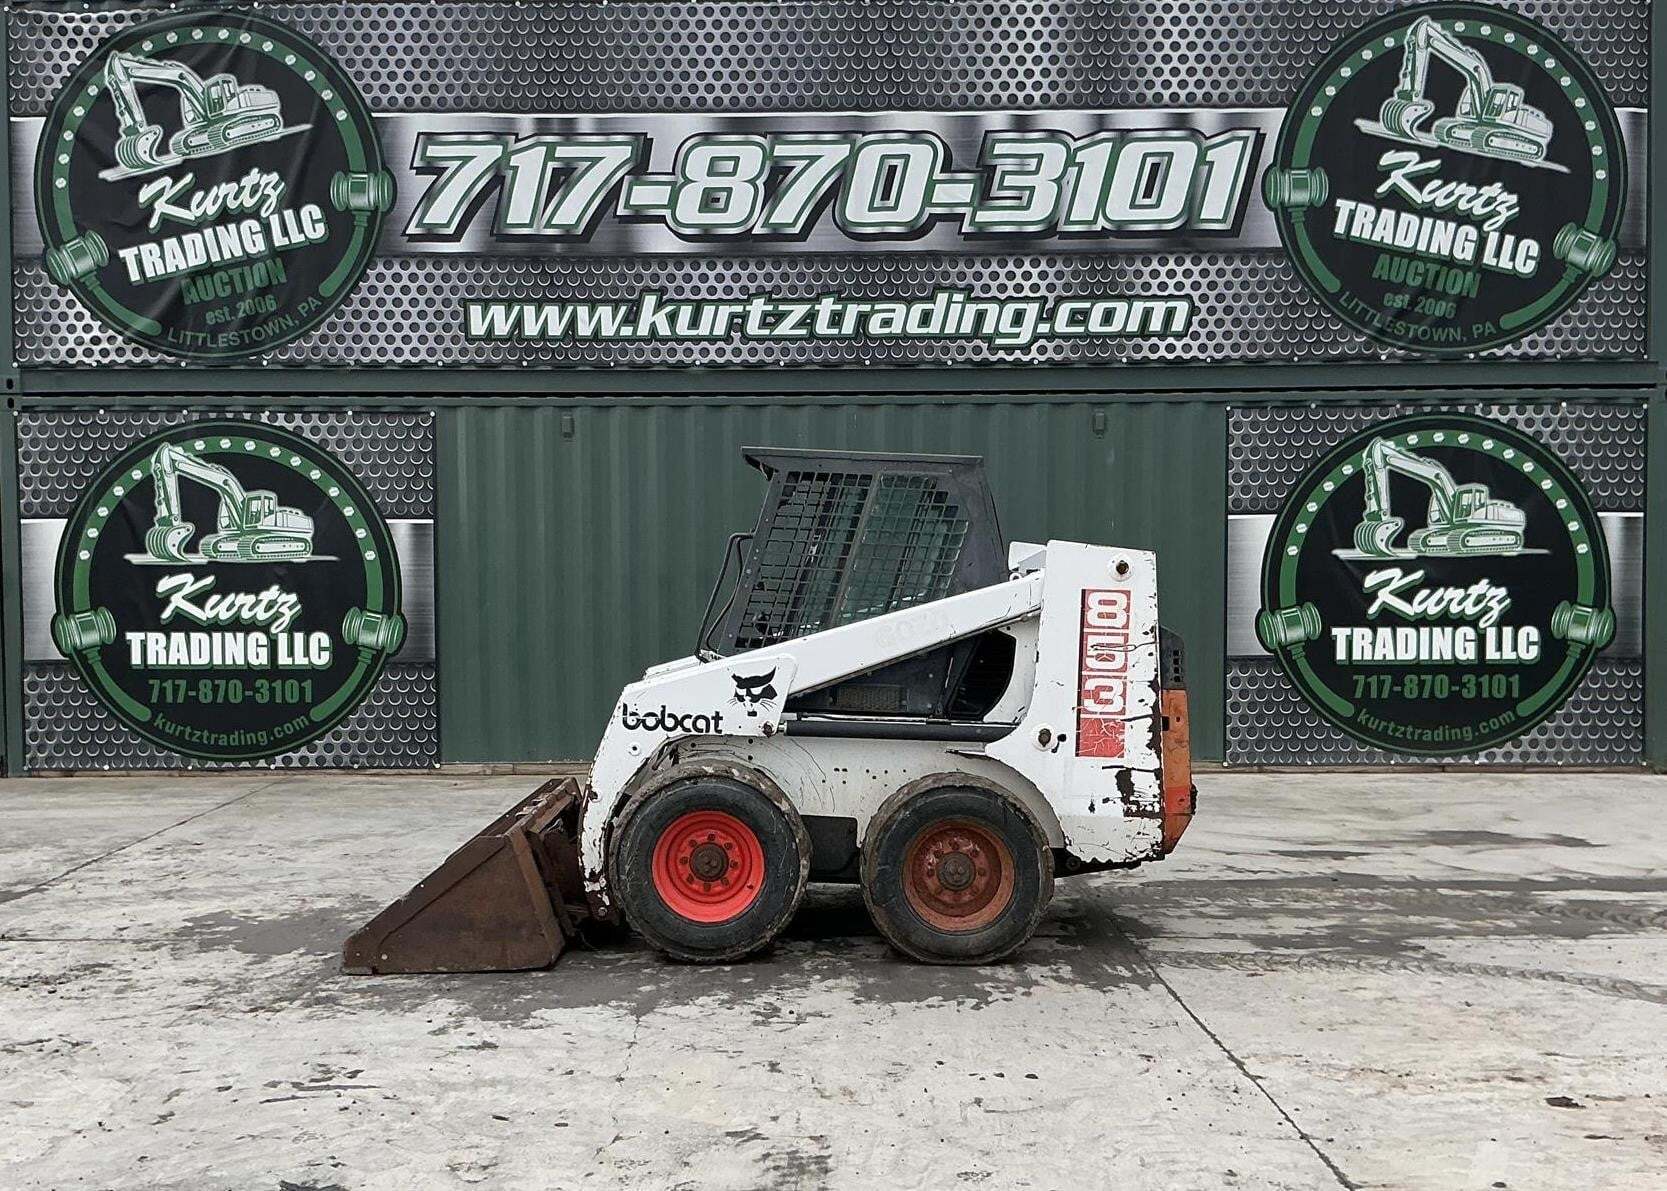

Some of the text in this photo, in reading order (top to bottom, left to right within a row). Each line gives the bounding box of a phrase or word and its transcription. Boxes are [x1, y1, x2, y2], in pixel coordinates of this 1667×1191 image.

[138, 168, 286, 229] Kurtz
[409, 132, 1260, 238] 717-870-3101
[1375, 149, 1521, 231] Kurtz
[118, 203, 329, 284] TRADING LLC
[1332, 198, 1541, 278] TRADING LLC
[181, 258, 288, 305] AUCTION
[1372, 253, 1481, 299] AUCTION
[166, 294, 323, 348] LITTLESTOWN, PA
[236, 294, 278, 317] 2006
[465, 288, 1194, 349] www.kurtztrading.com
[1338, 290, 1498, 343] LITTLESTOWN, PA
[1415, 296, 1457, 318] 2006
[155, 572, 303, 632] Kurtz
[1364, 567, 1513, 629] Kurtz
[125, 631, 333, 669] TRADING LLC
[1331, 626, 1541, 665] TRADING LLC
[148, 678, 313, 705] 717-870-3101
[1352, 673, 1521, 701] 717-870-3101
[154, 713, 309, 747] kurtztrading.com
[622, 703, 724, 735] bobcat
[1357, 708, 1515, 742] kurtztrading.com
